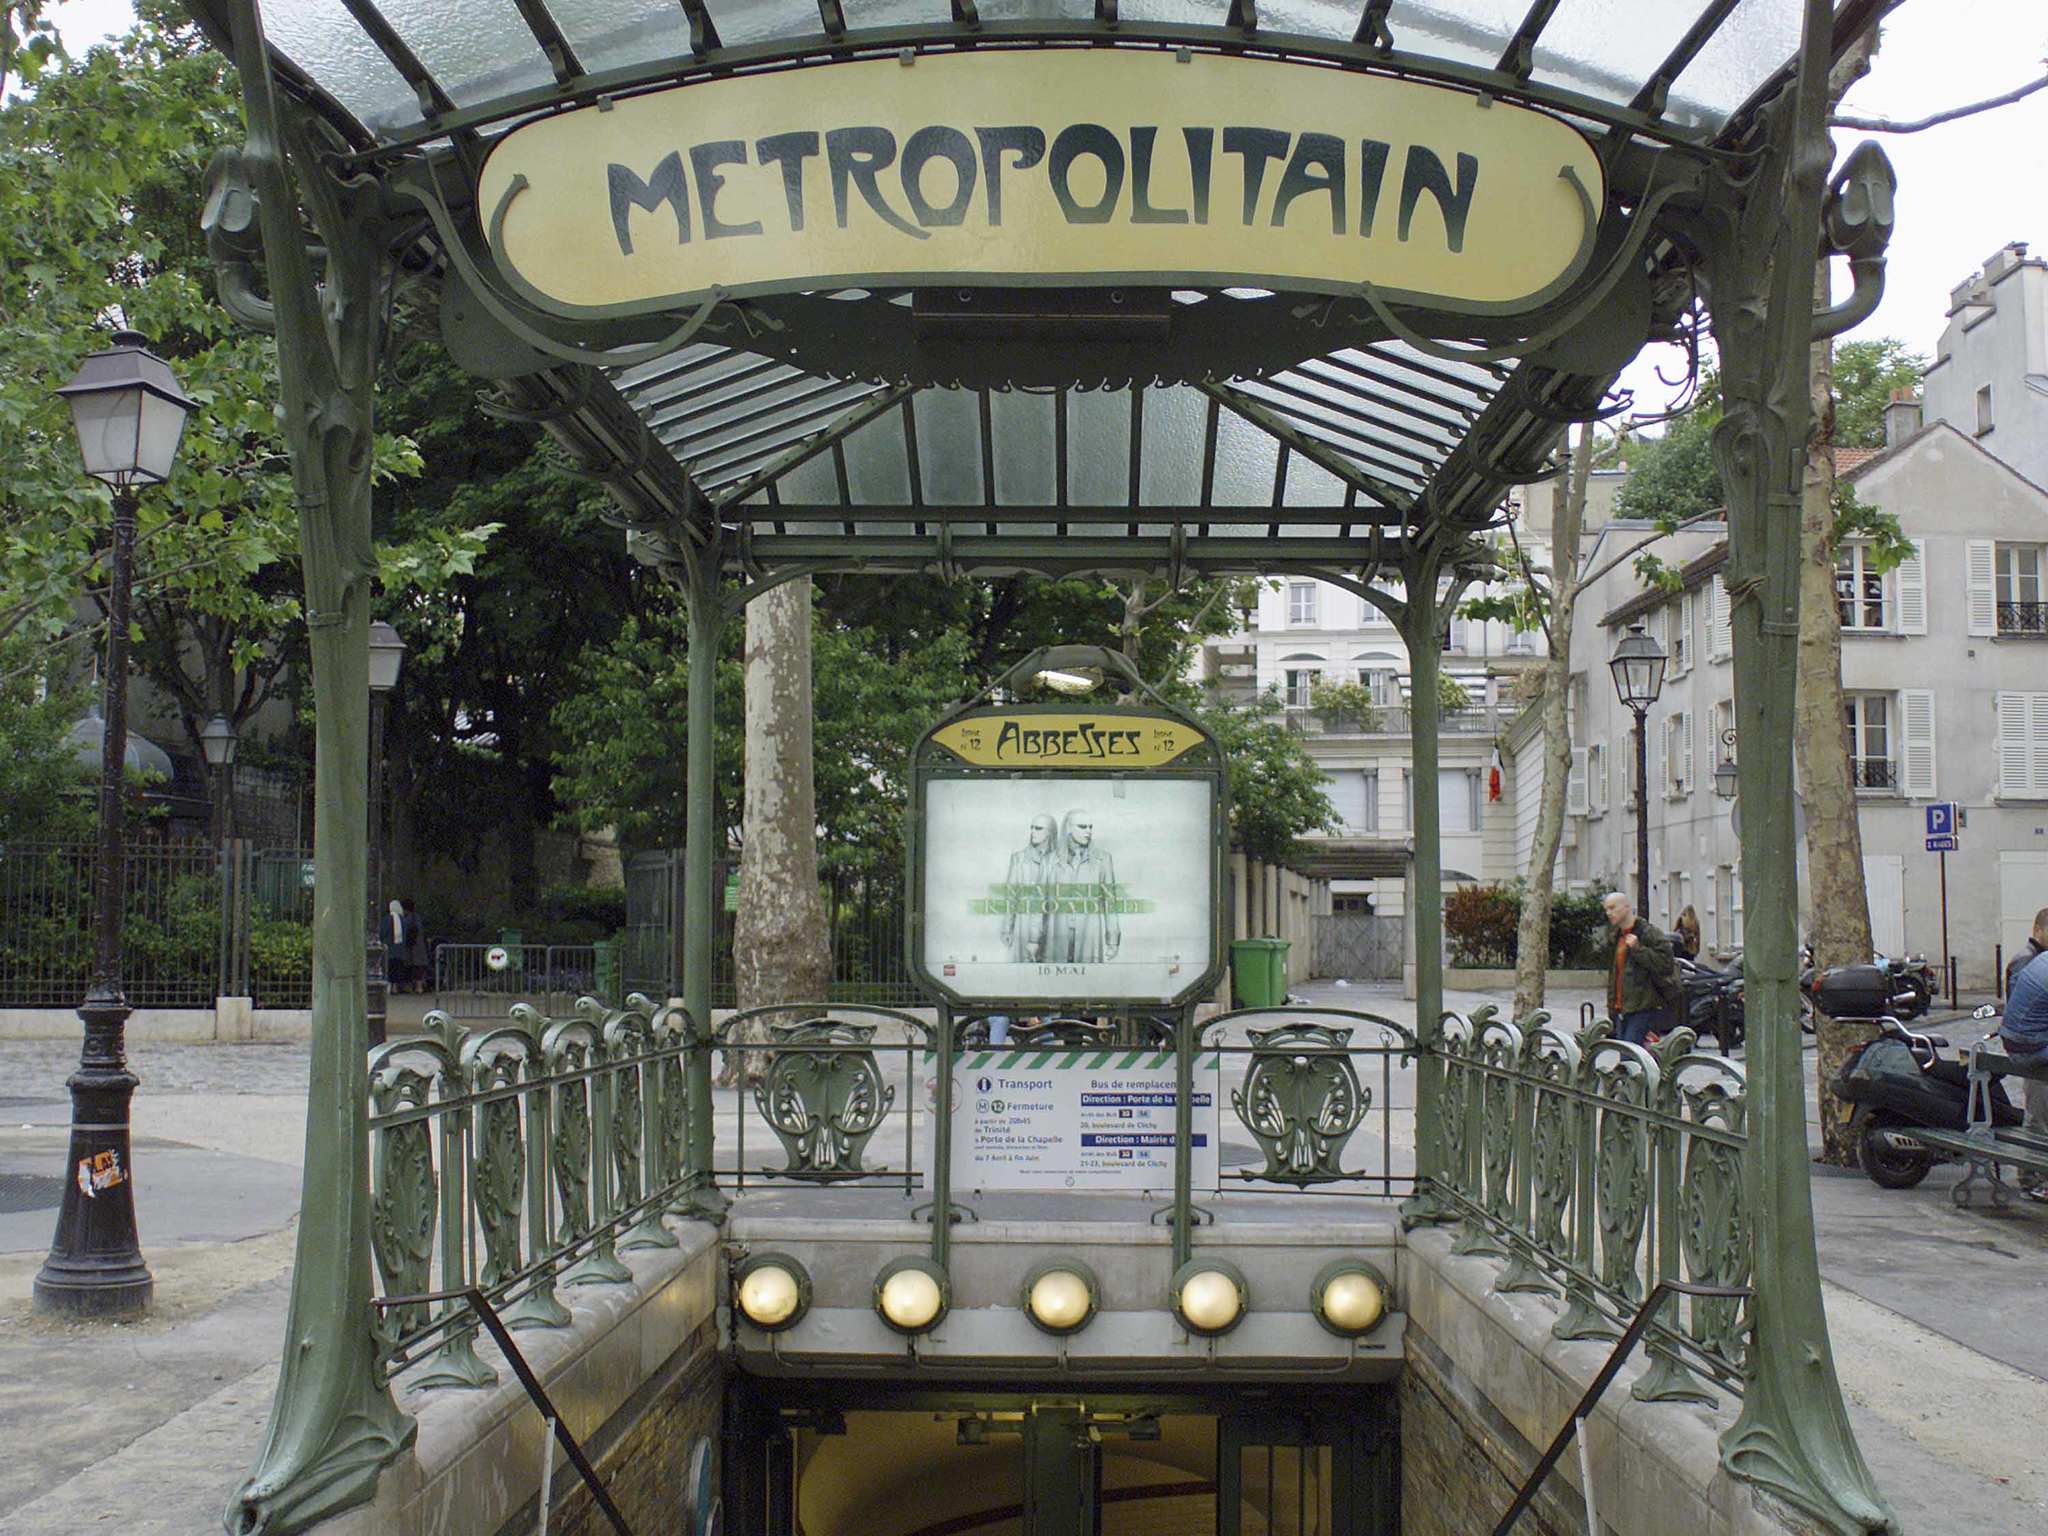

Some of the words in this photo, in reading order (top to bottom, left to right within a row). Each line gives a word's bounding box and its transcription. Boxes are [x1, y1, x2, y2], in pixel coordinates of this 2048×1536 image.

[606, 123, 1478, 256] METROPOLITAIN
[970, 738, 981, 751] 12
[996, 721, 1140, 759] ABBESSES
[1163, 739, 1175, 751] 12
[1932, 808, 1945, 830] P
[984, 899, 1139, 913] RELOADED
[1056, 967, 1086, 976] MAI
[998, 1079, 1053, 1090] Transport
[1091, 1079, 1109, 1089] Bus
[1111, 1079, 1124, 1089] de
[1082, 1094, 1121, 1104] Direction
[1128, 1095, 1150, 1104] Porte
[1152, 1094, 1163, 1104] de
[1164, 1094, 1173, 1104] la
[1007, 1102, 1054, 1111] Fermeture
[1137, 1121, 1157, 1130] Clichy
[981, 1135, 1003, 1143] Porte
[1005, 1135, 1016, 1143] de
[1018, 1135, 1025, 1143] la
[1027, 1135, 1063, 1145] Chapelle
[1095, 1135, 1134, 1144] Direction
[1140, 1135, 1168, 1144] Mairie
